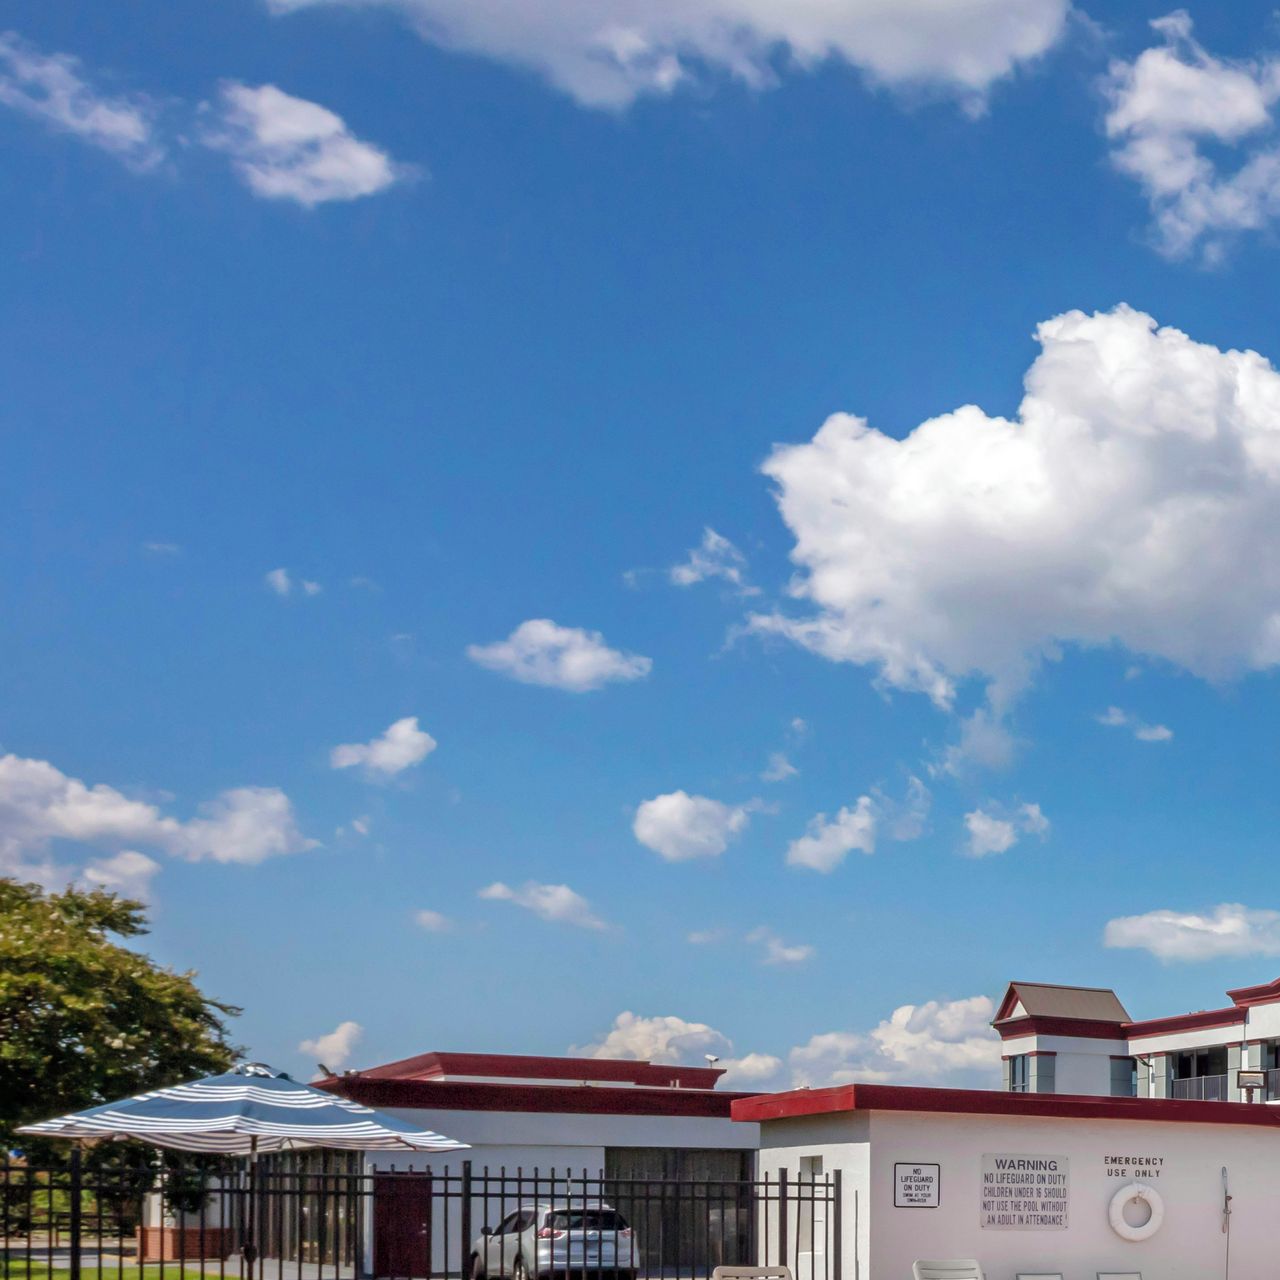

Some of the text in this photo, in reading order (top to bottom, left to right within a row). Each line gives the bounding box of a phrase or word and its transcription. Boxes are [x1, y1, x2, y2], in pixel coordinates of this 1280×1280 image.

[995, 1159, 1058, 1171] WARNING
[1104, 1156, 1164, 1166] EMERGENCY
[984, 1172, 1066, 1185] NO LIFEGUARD ON DUTY
[1107, 1168, 1161, 1178] USE ONLY
[983, 1186, 1013, 1198] CHILDREN
[1014, 1187, 1034, 1198] UNDER
[1044, 1187, 1067, 1199] SHOULD
[982, 1200, 1067, 1212] NOT USE THE POOL WITHOUT
[986, 1214, 1063, 1226] AN ADULT IN ATTENDANCE
